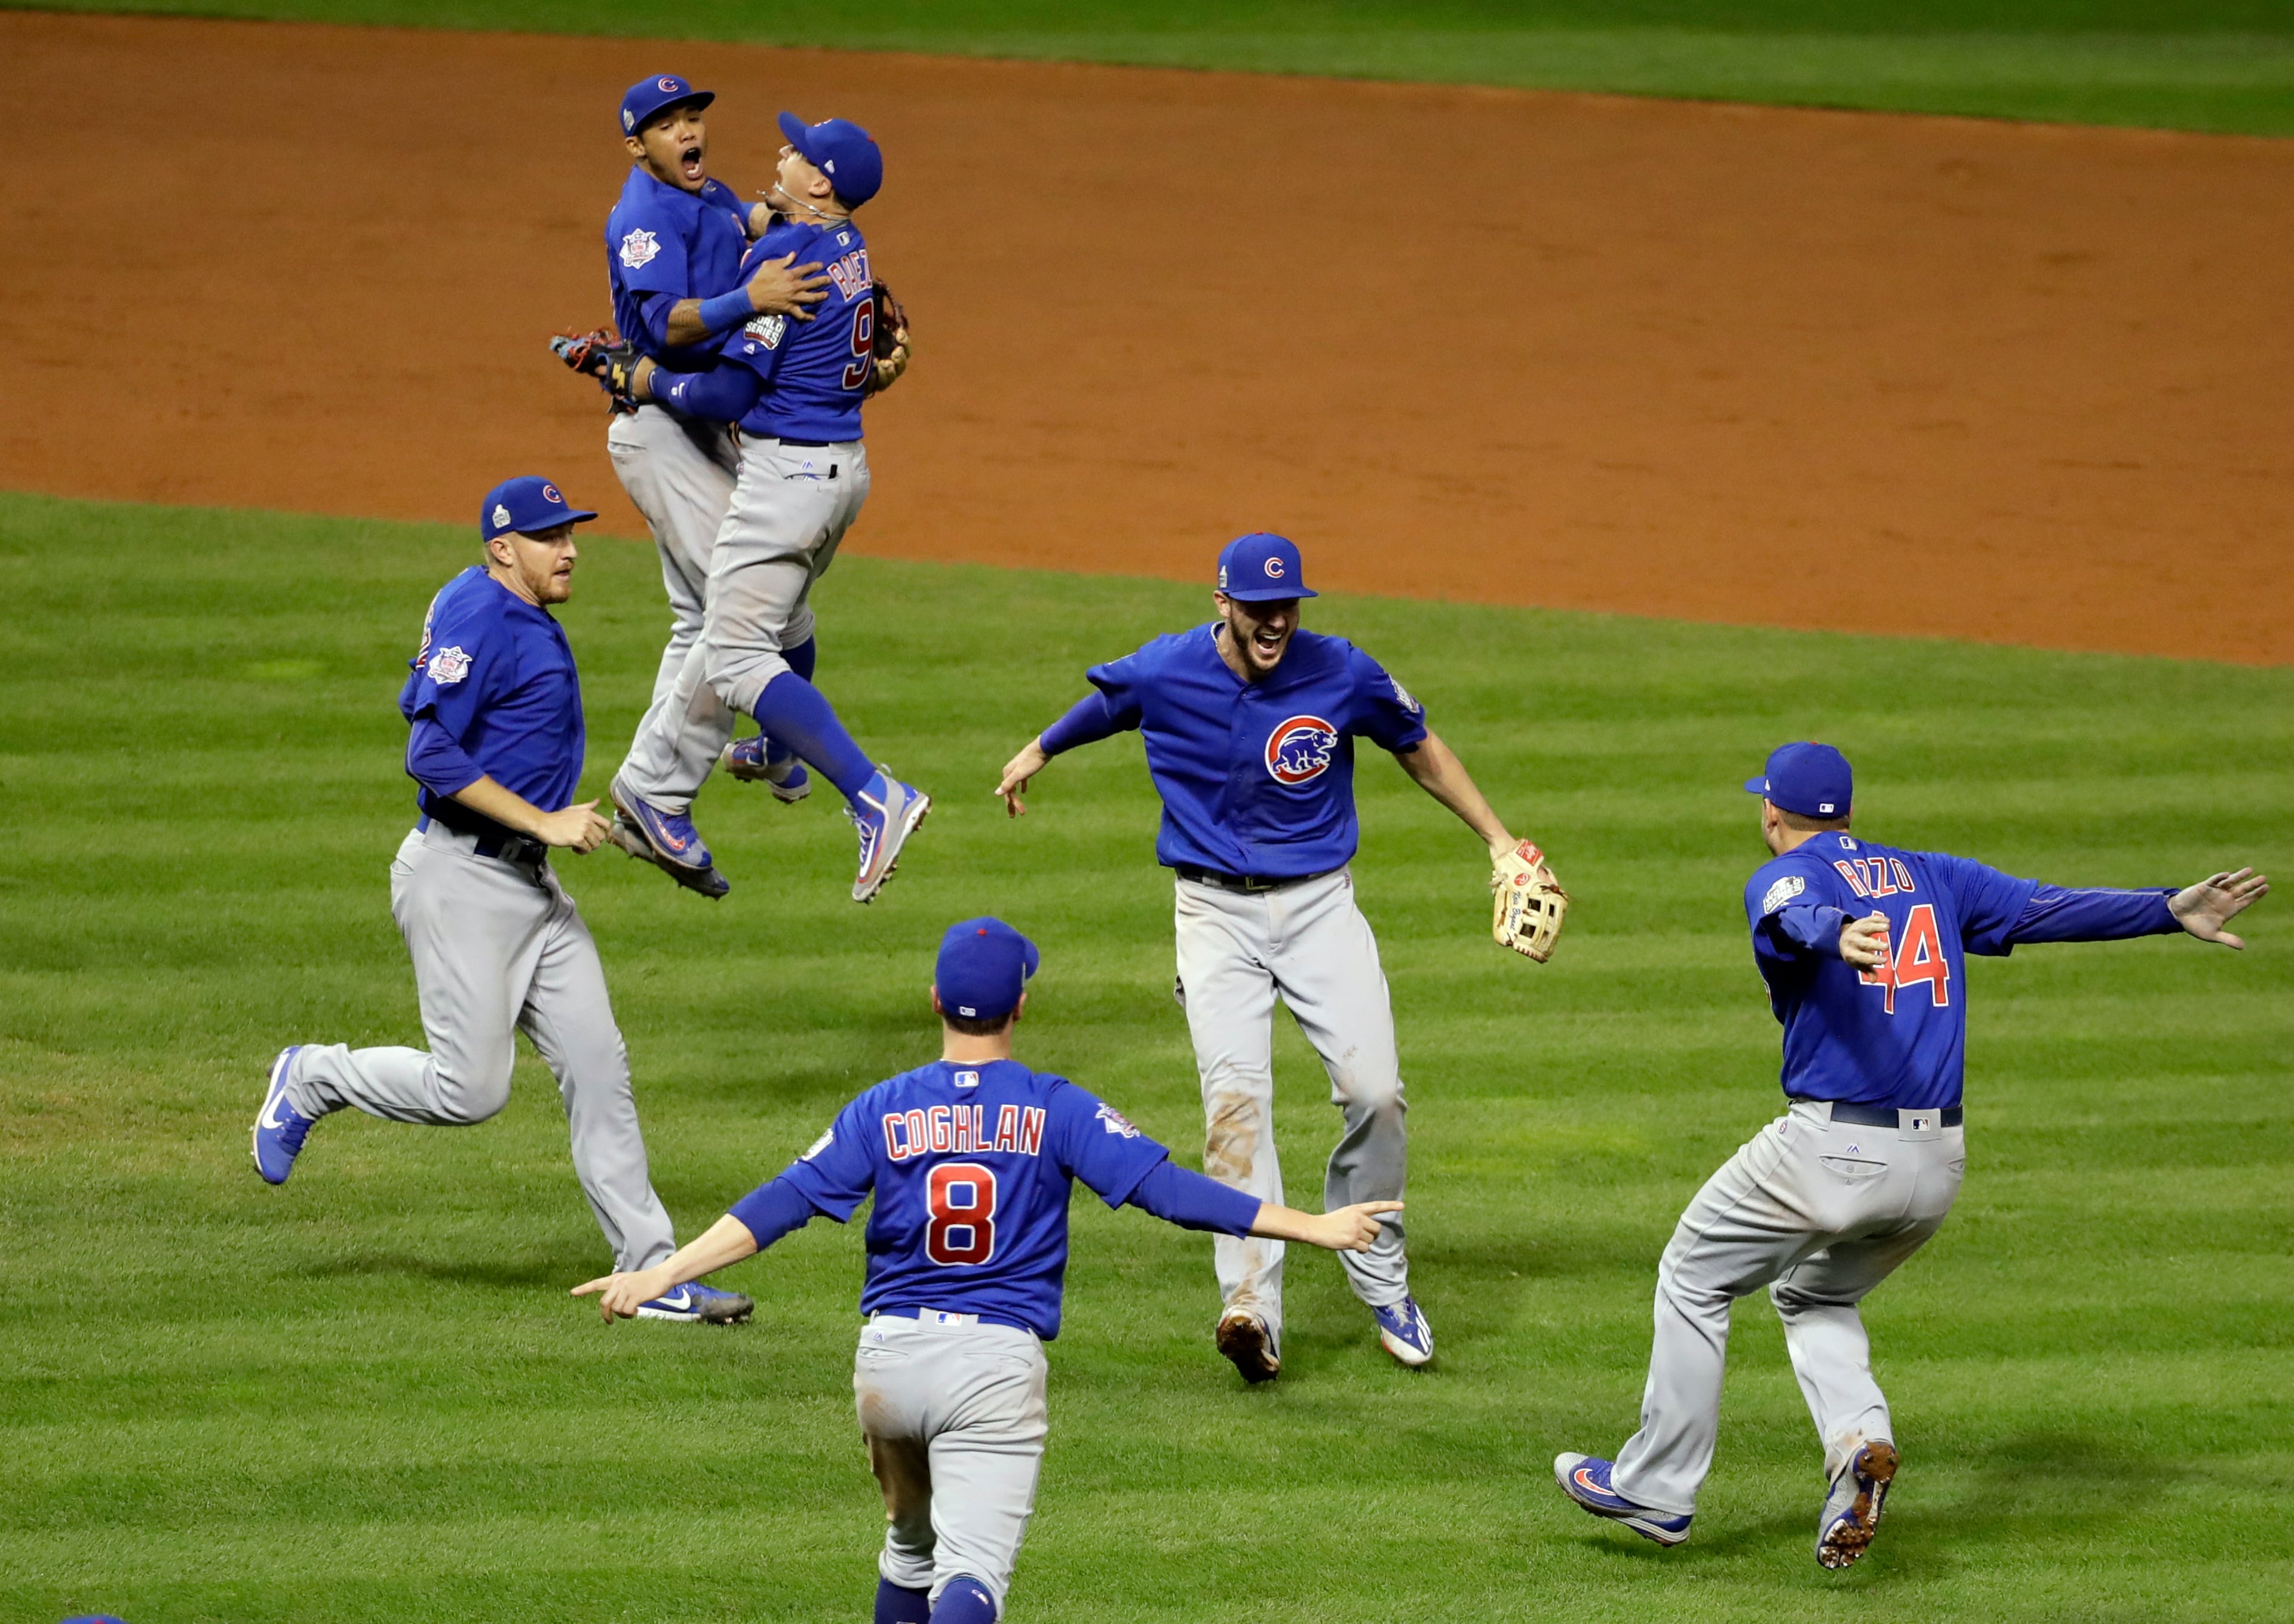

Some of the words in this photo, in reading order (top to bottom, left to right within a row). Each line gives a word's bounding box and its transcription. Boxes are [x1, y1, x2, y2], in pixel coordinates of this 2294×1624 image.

[827, 249, 873, 302] BAEZ
[746, 321, 779, 344] SERIES
[753, 315, 784, 333] ORLD
[842, 297, 874, 390] 9
[1264, 557, 1284, 578] C
[1833, 857, 1915, 898] RZZO
[1858, 904, 1950, 1015] 44
[883, 1104, 1045, 1161] COGHLAN
[925, 1163, 996, 1266] 8
